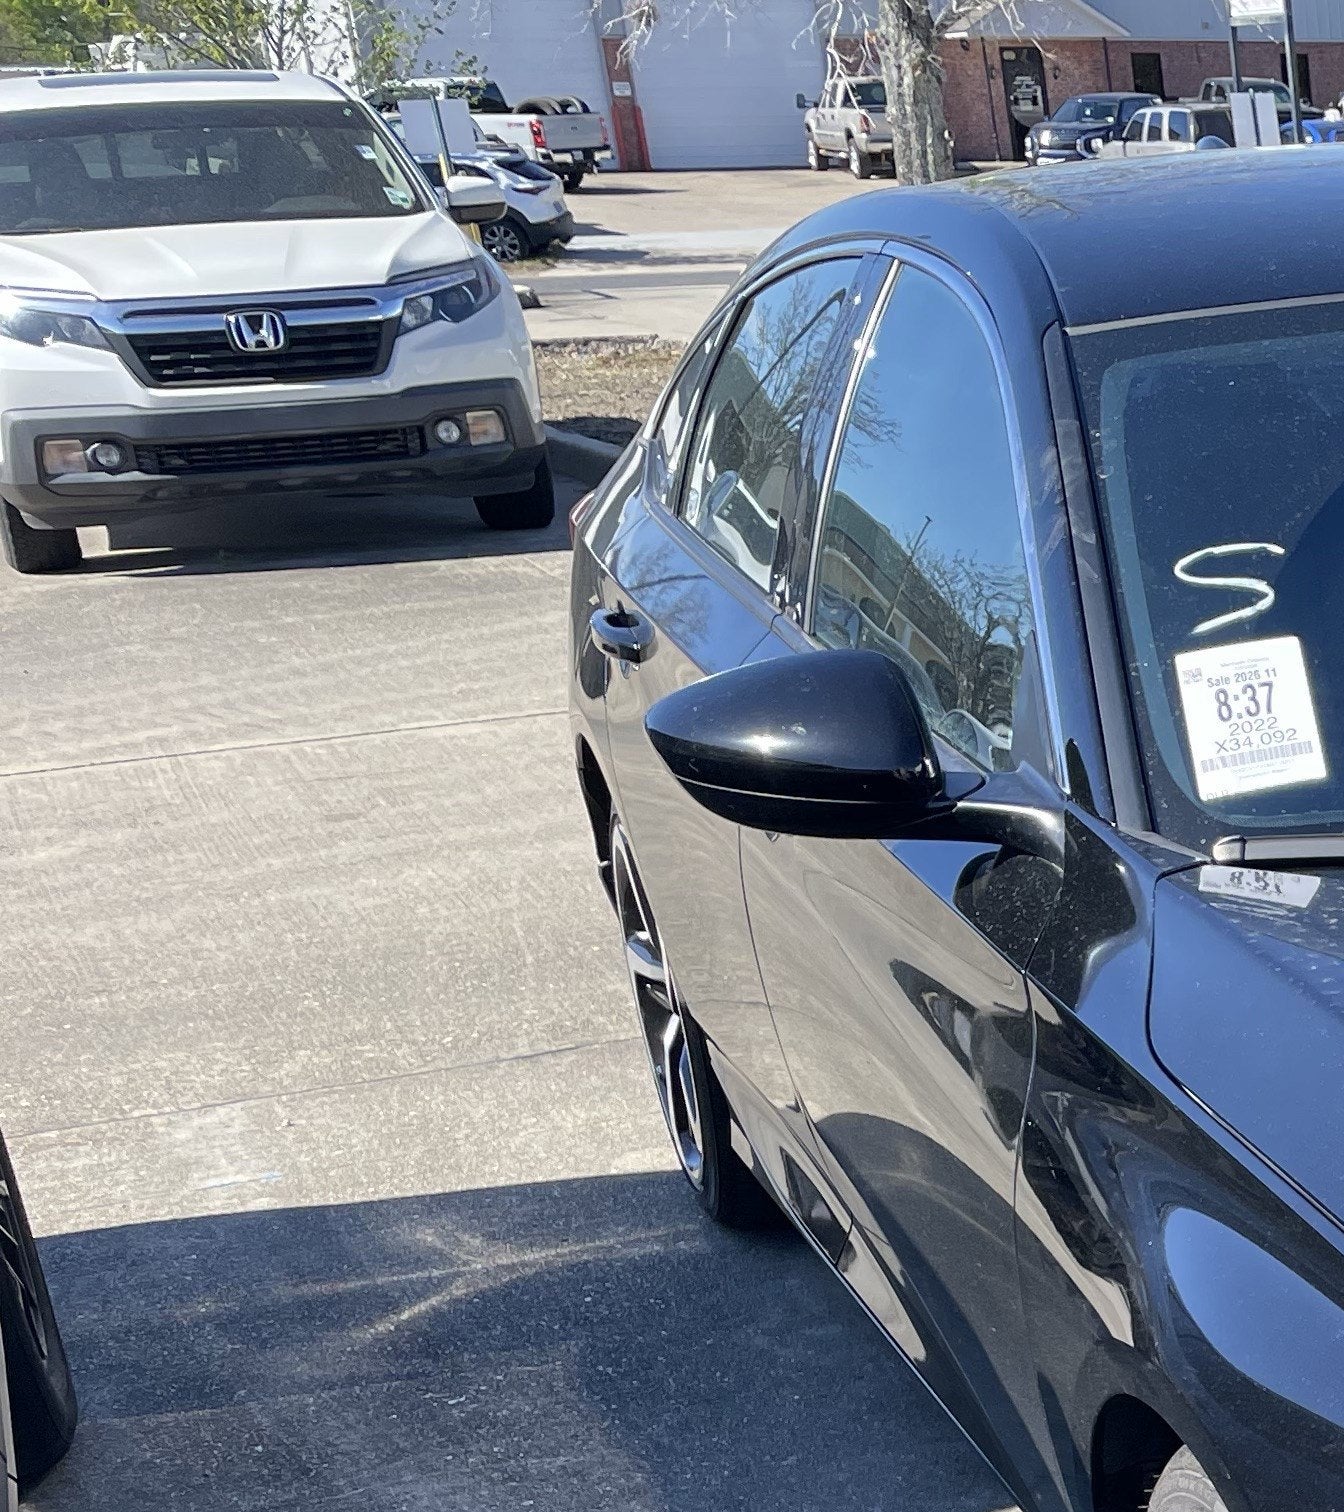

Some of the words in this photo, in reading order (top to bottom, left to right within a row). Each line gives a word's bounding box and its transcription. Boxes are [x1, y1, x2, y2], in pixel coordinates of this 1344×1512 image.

[1206, 676, 1231, 688] Sale
[1214, 681, 1274, 722] 8:37
[1228, 716, 1279, 737] 2022
[1214, 728, 1299, 754] X34,092
